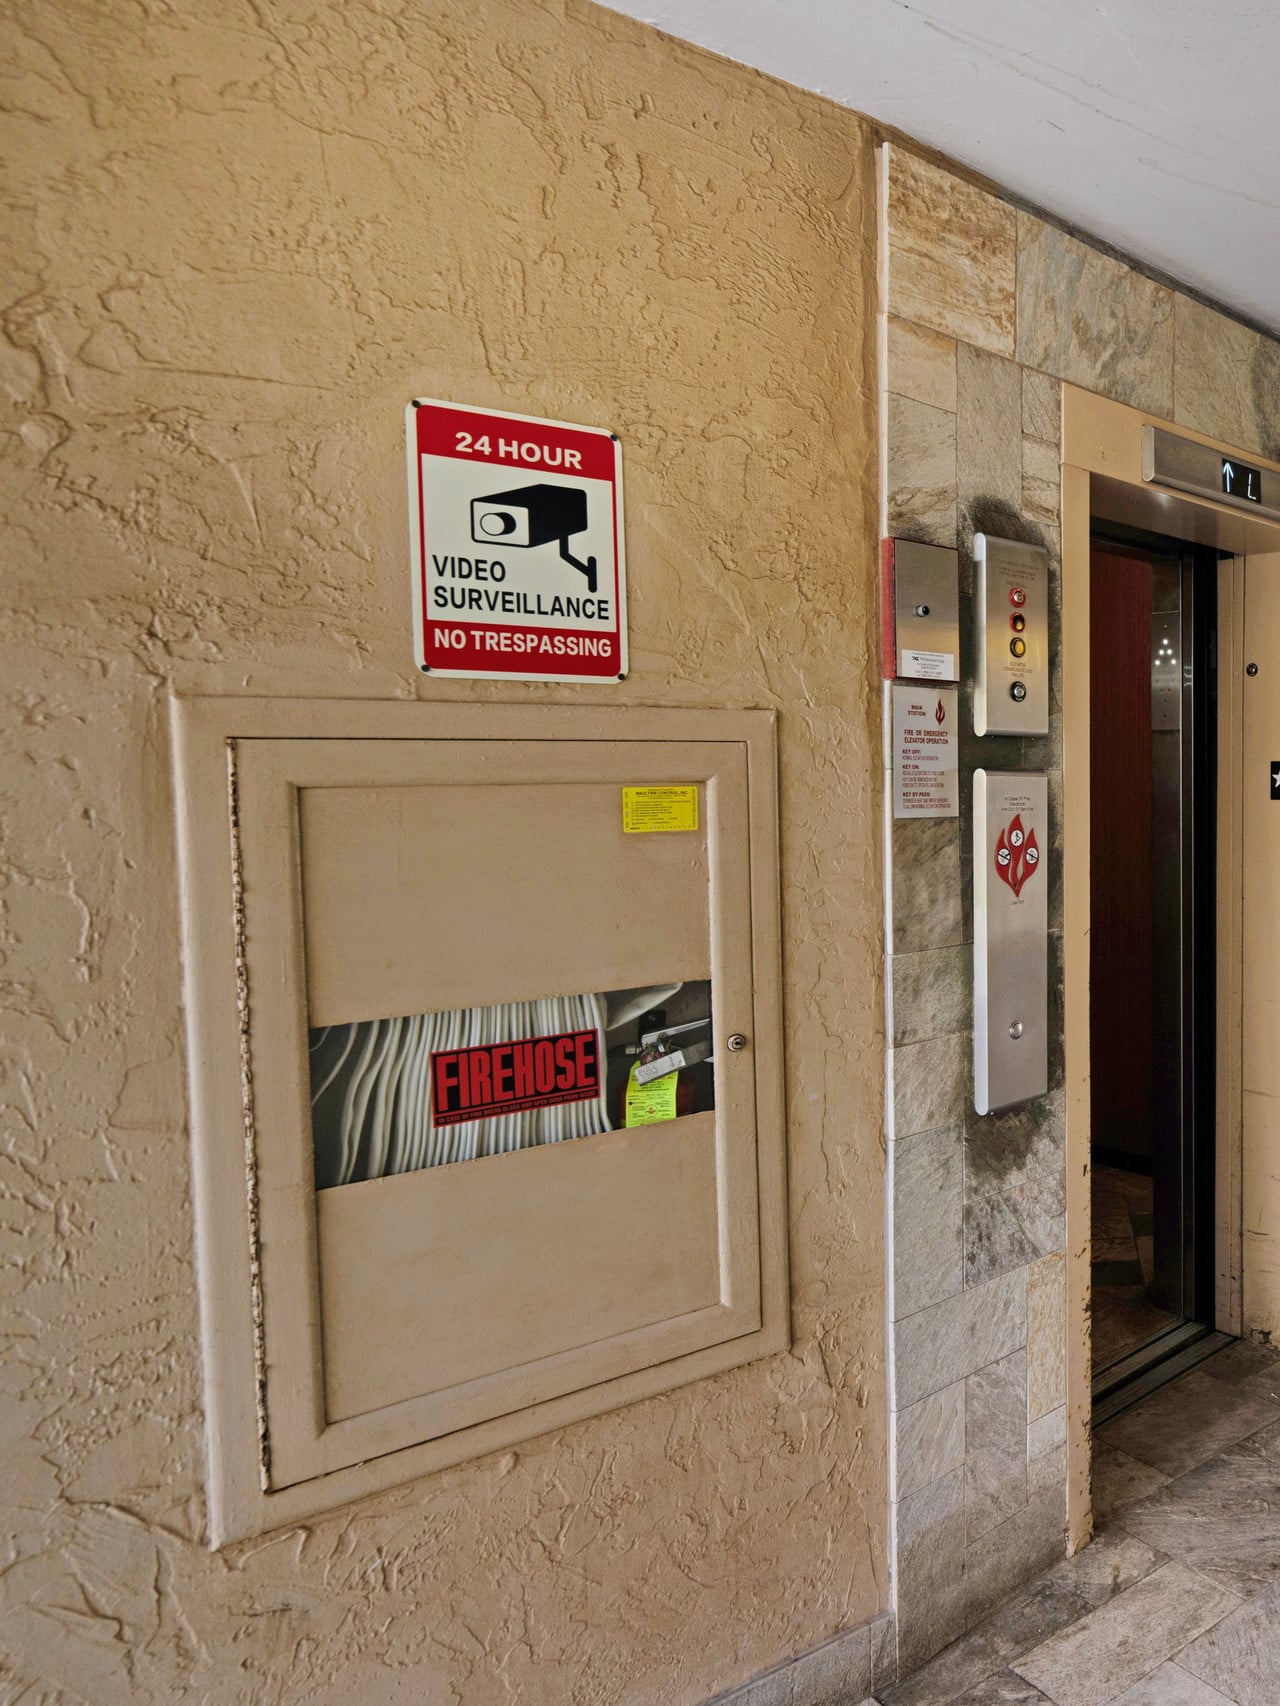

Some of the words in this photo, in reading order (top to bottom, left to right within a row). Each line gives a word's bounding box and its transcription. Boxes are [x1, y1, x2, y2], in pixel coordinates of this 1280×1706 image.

[455, 431, 492, 456] 24
[498, 437, 583, 470] HOUR
[1247, 472, 1257, 500] L
[431, 554, 506, 582] VIDEO
[433, 585, 610, 620] SURVEILLANCE
[433, 627, 467, 650] NO
[470, 630, 612, 658] TRESPASSING
[904, 728, 914, 736] FIRE
[904, 736, 925, 744] ELEVATOR
[926, 737, 949, 745] OPERATION
[436, 1033, 596, 1113] FIREHOSE
